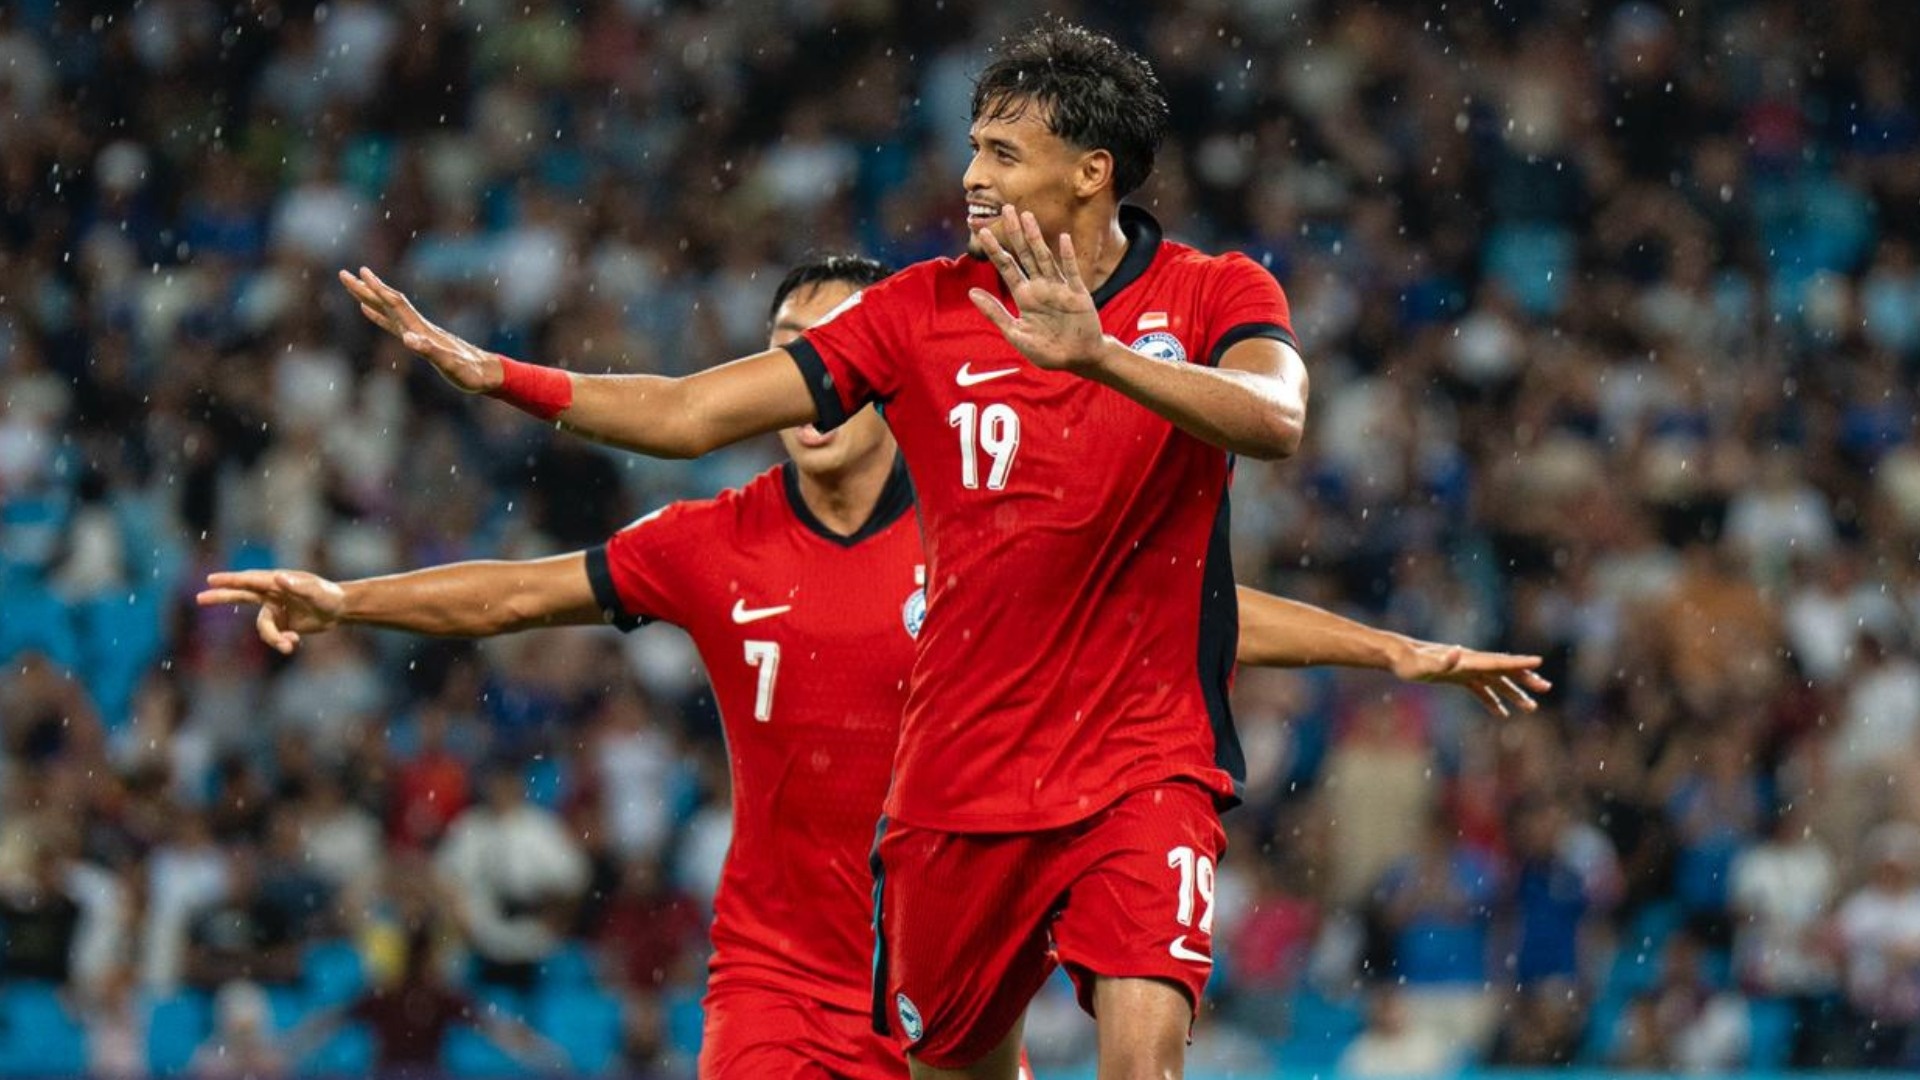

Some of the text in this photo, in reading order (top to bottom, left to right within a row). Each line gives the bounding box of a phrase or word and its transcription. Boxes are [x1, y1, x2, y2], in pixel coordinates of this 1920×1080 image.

[949, 402, 1021, 490] 19
[743, 640, 780, 722] 7
[1167, 845, 1214, 935] 19
